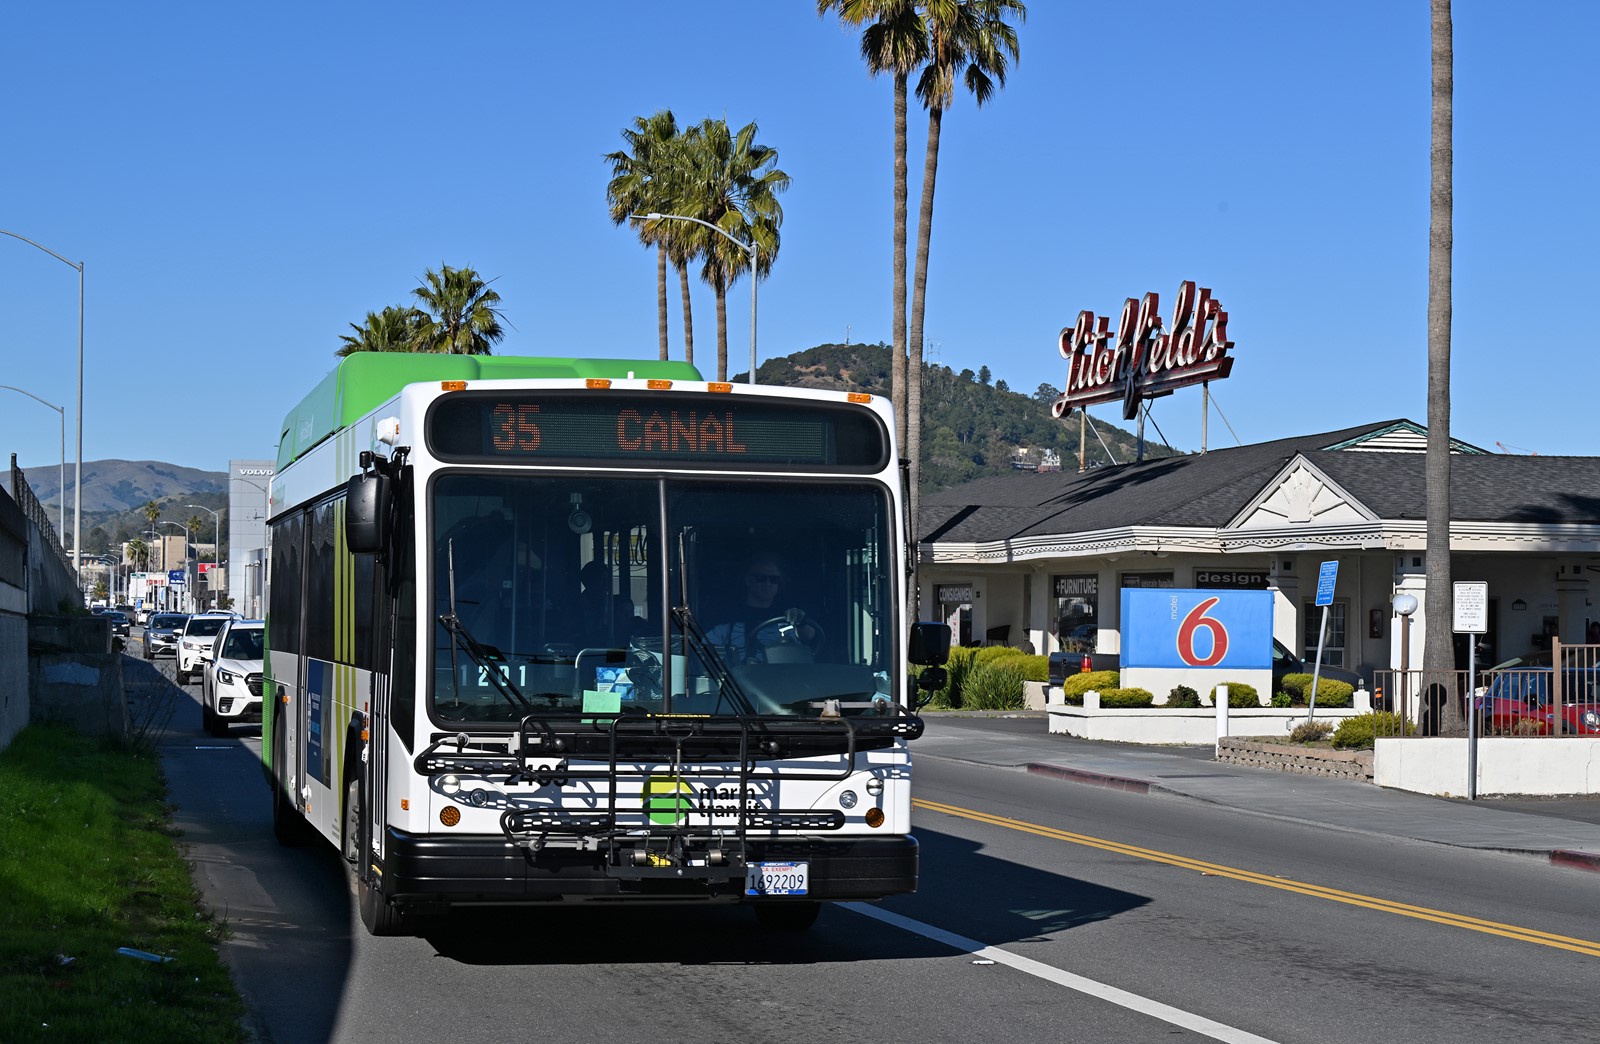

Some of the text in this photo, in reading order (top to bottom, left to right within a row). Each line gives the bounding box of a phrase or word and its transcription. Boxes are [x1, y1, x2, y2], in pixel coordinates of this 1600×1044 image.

[1052, 280, 1235, 420] Litchfield's
[493, 403, 747, 454] 35 CANAL
[239, 468, 275, 476] VOLVO
[1060, 578, 1097, 594] FURNITURE
[1197, 572, 1262, 585] design
[938, 587, 973, 602] CONSIGNMEN
[1170, 595, 1178, 620] motel
[1176, 596, 1229, 667] 6
[700, 787, 756, 800] marn
[699, 801, 761, 818] tranit
[750, 874, 804, 889] 1692209
